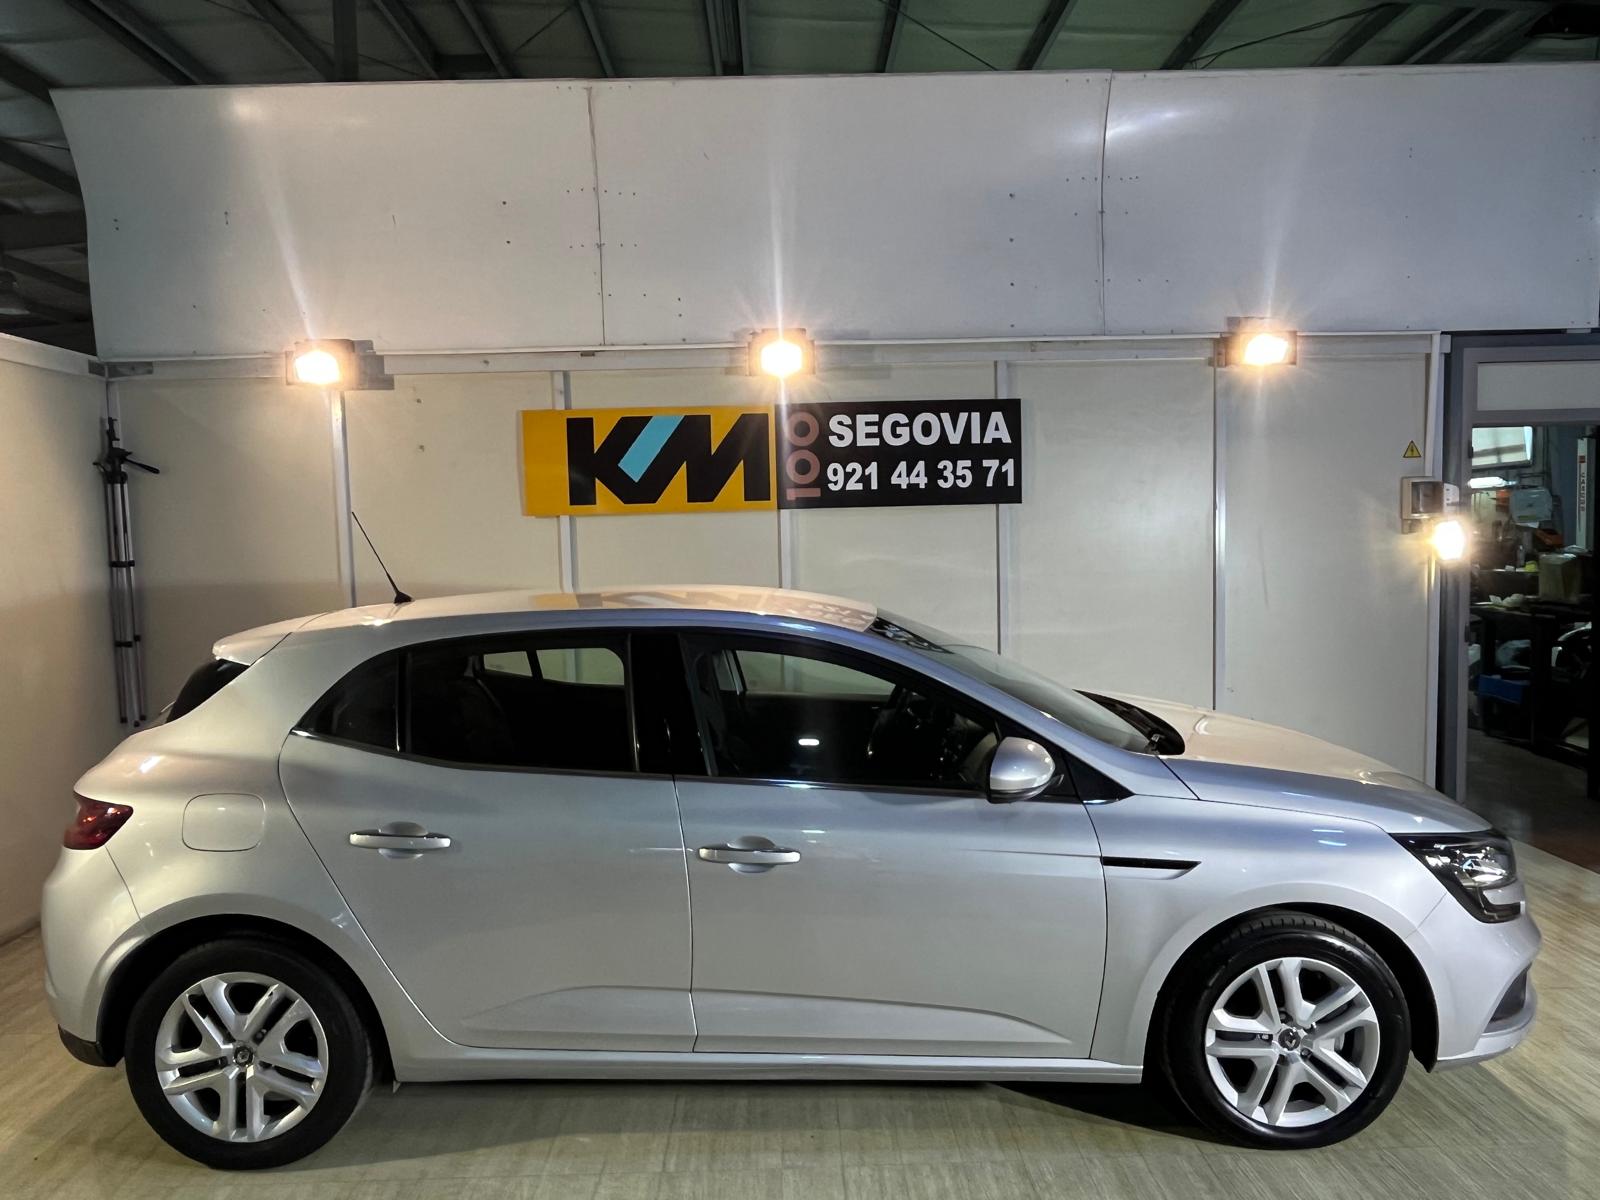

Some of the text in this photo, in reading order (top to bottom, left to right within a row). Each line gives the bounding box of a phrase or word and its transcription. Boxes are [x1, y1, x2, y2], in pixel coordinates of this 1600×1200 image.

[828, 411, 1012, 448] SEGOVIA
[567, 413, 771, 506] KM
[827, 458, 1014, 491] 921 44 35 71
